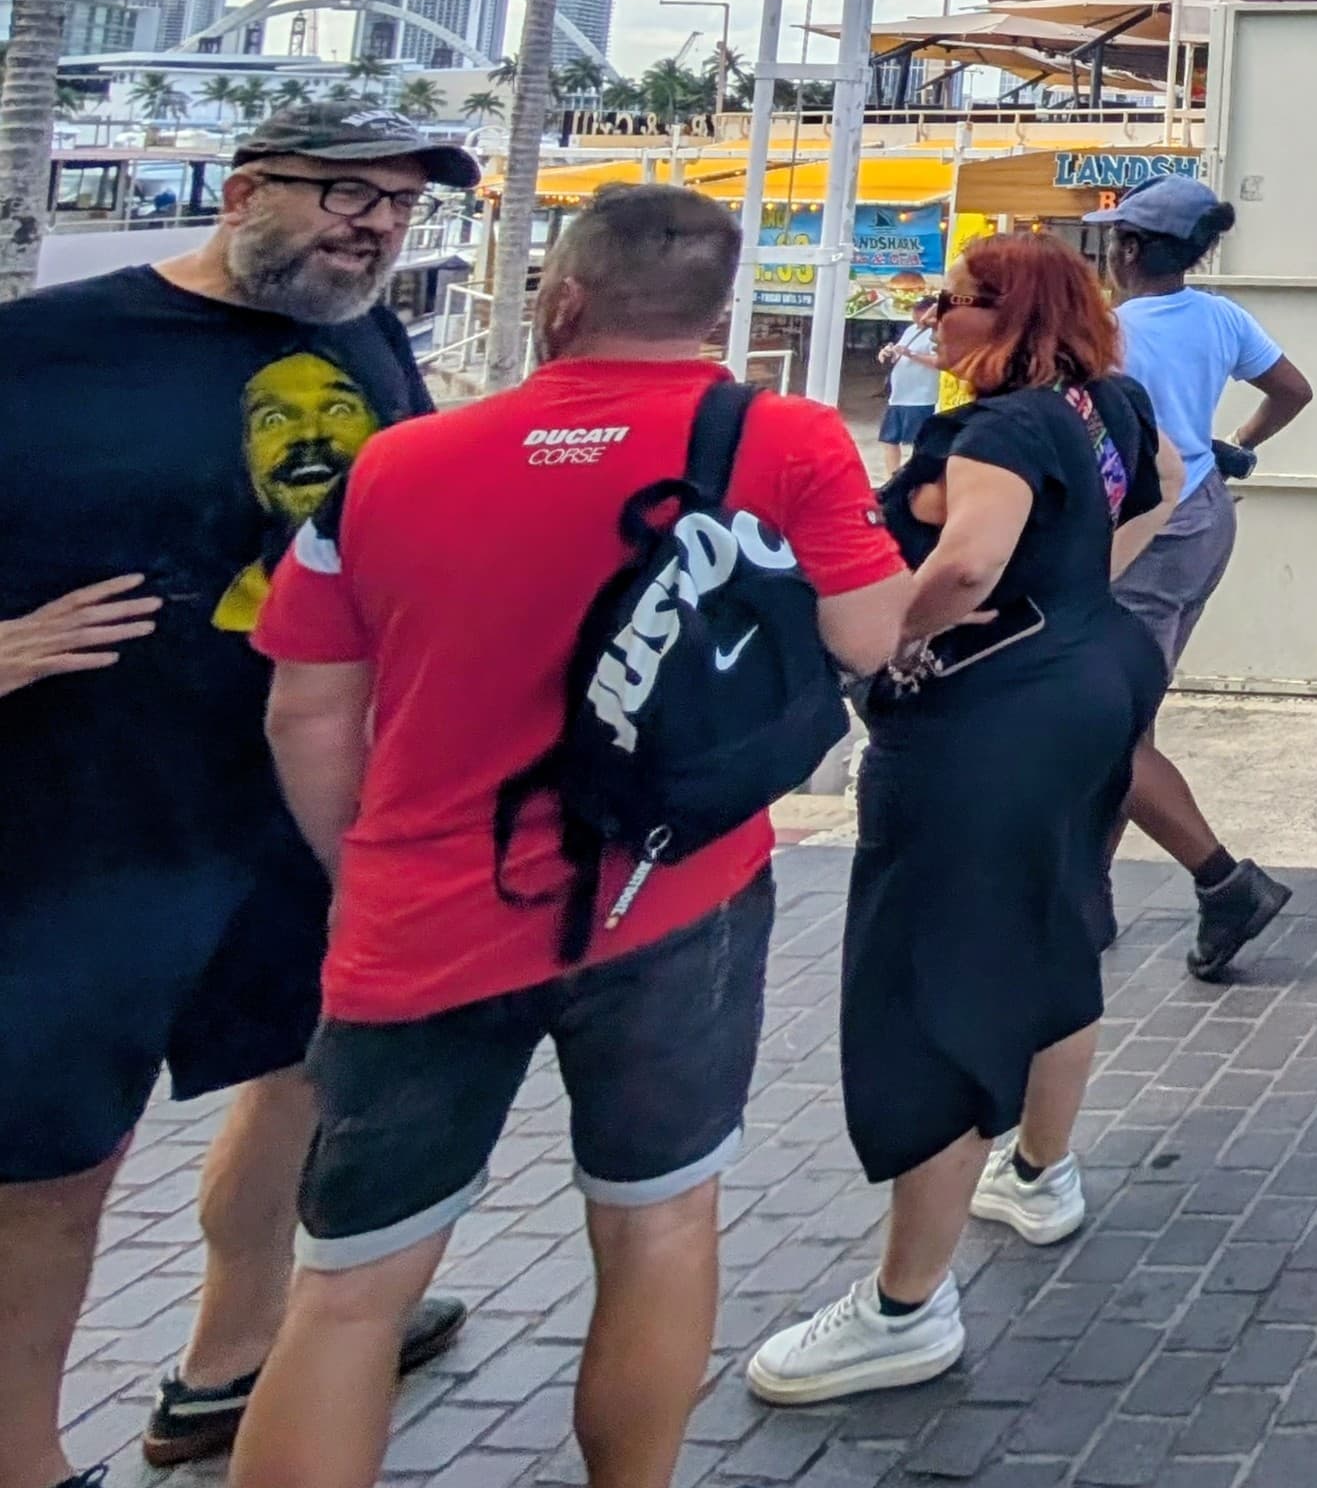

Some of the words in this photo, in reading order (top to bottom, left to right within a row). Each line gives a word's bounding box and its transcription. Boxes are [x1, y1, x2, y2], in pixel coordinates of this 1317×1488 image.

[853, 236, 920, 250] NDSHARK
[523, 426, 629, 446] DUCATI
[528, 447, 606, 465] CORSE
[586, 555, 699, 754] JUST
